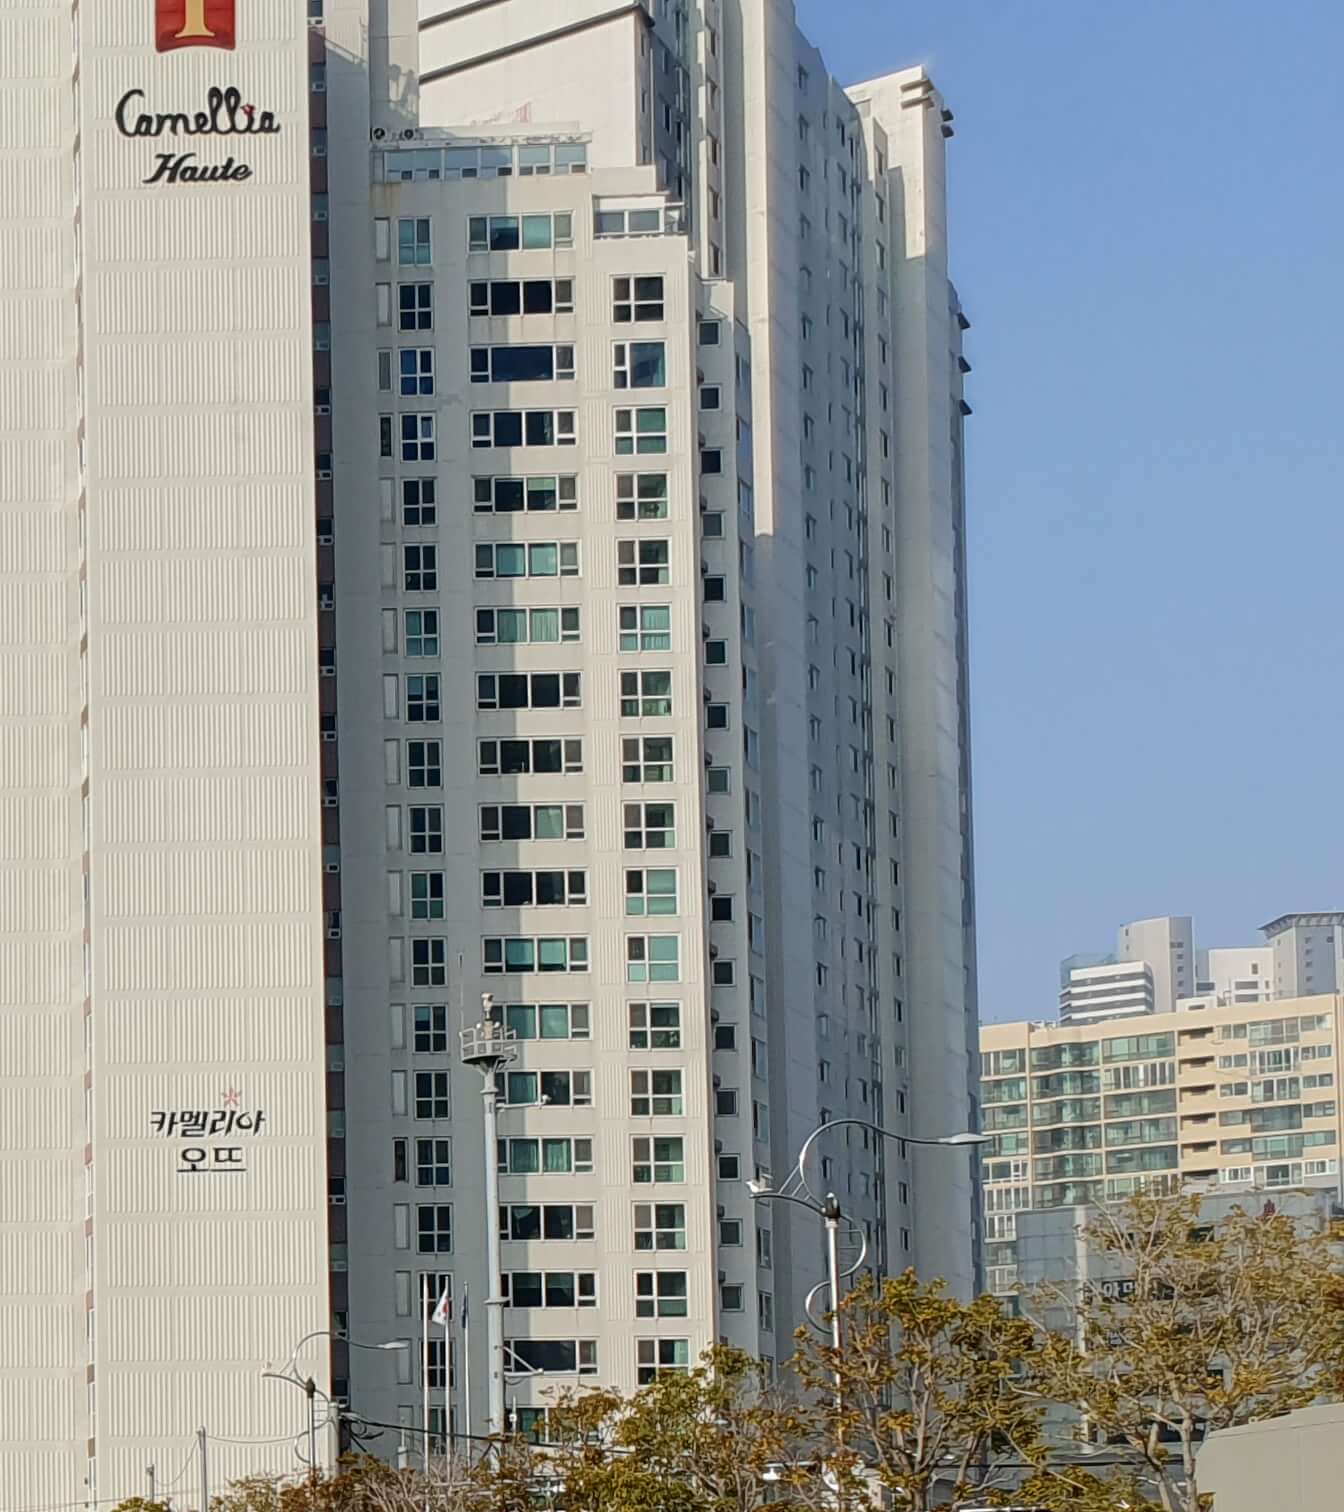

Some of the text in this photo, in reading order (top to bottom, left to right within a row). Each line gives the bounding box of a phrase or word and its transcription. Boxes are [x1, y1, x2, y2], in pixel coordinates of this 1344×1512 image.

[116, 87, 280, 137] Camellia
[143, 153, 252, 183] Haute
[151, 1110, 266, 1137] 카멜리아
[177, 1147, 247, 1172] 오뜨
